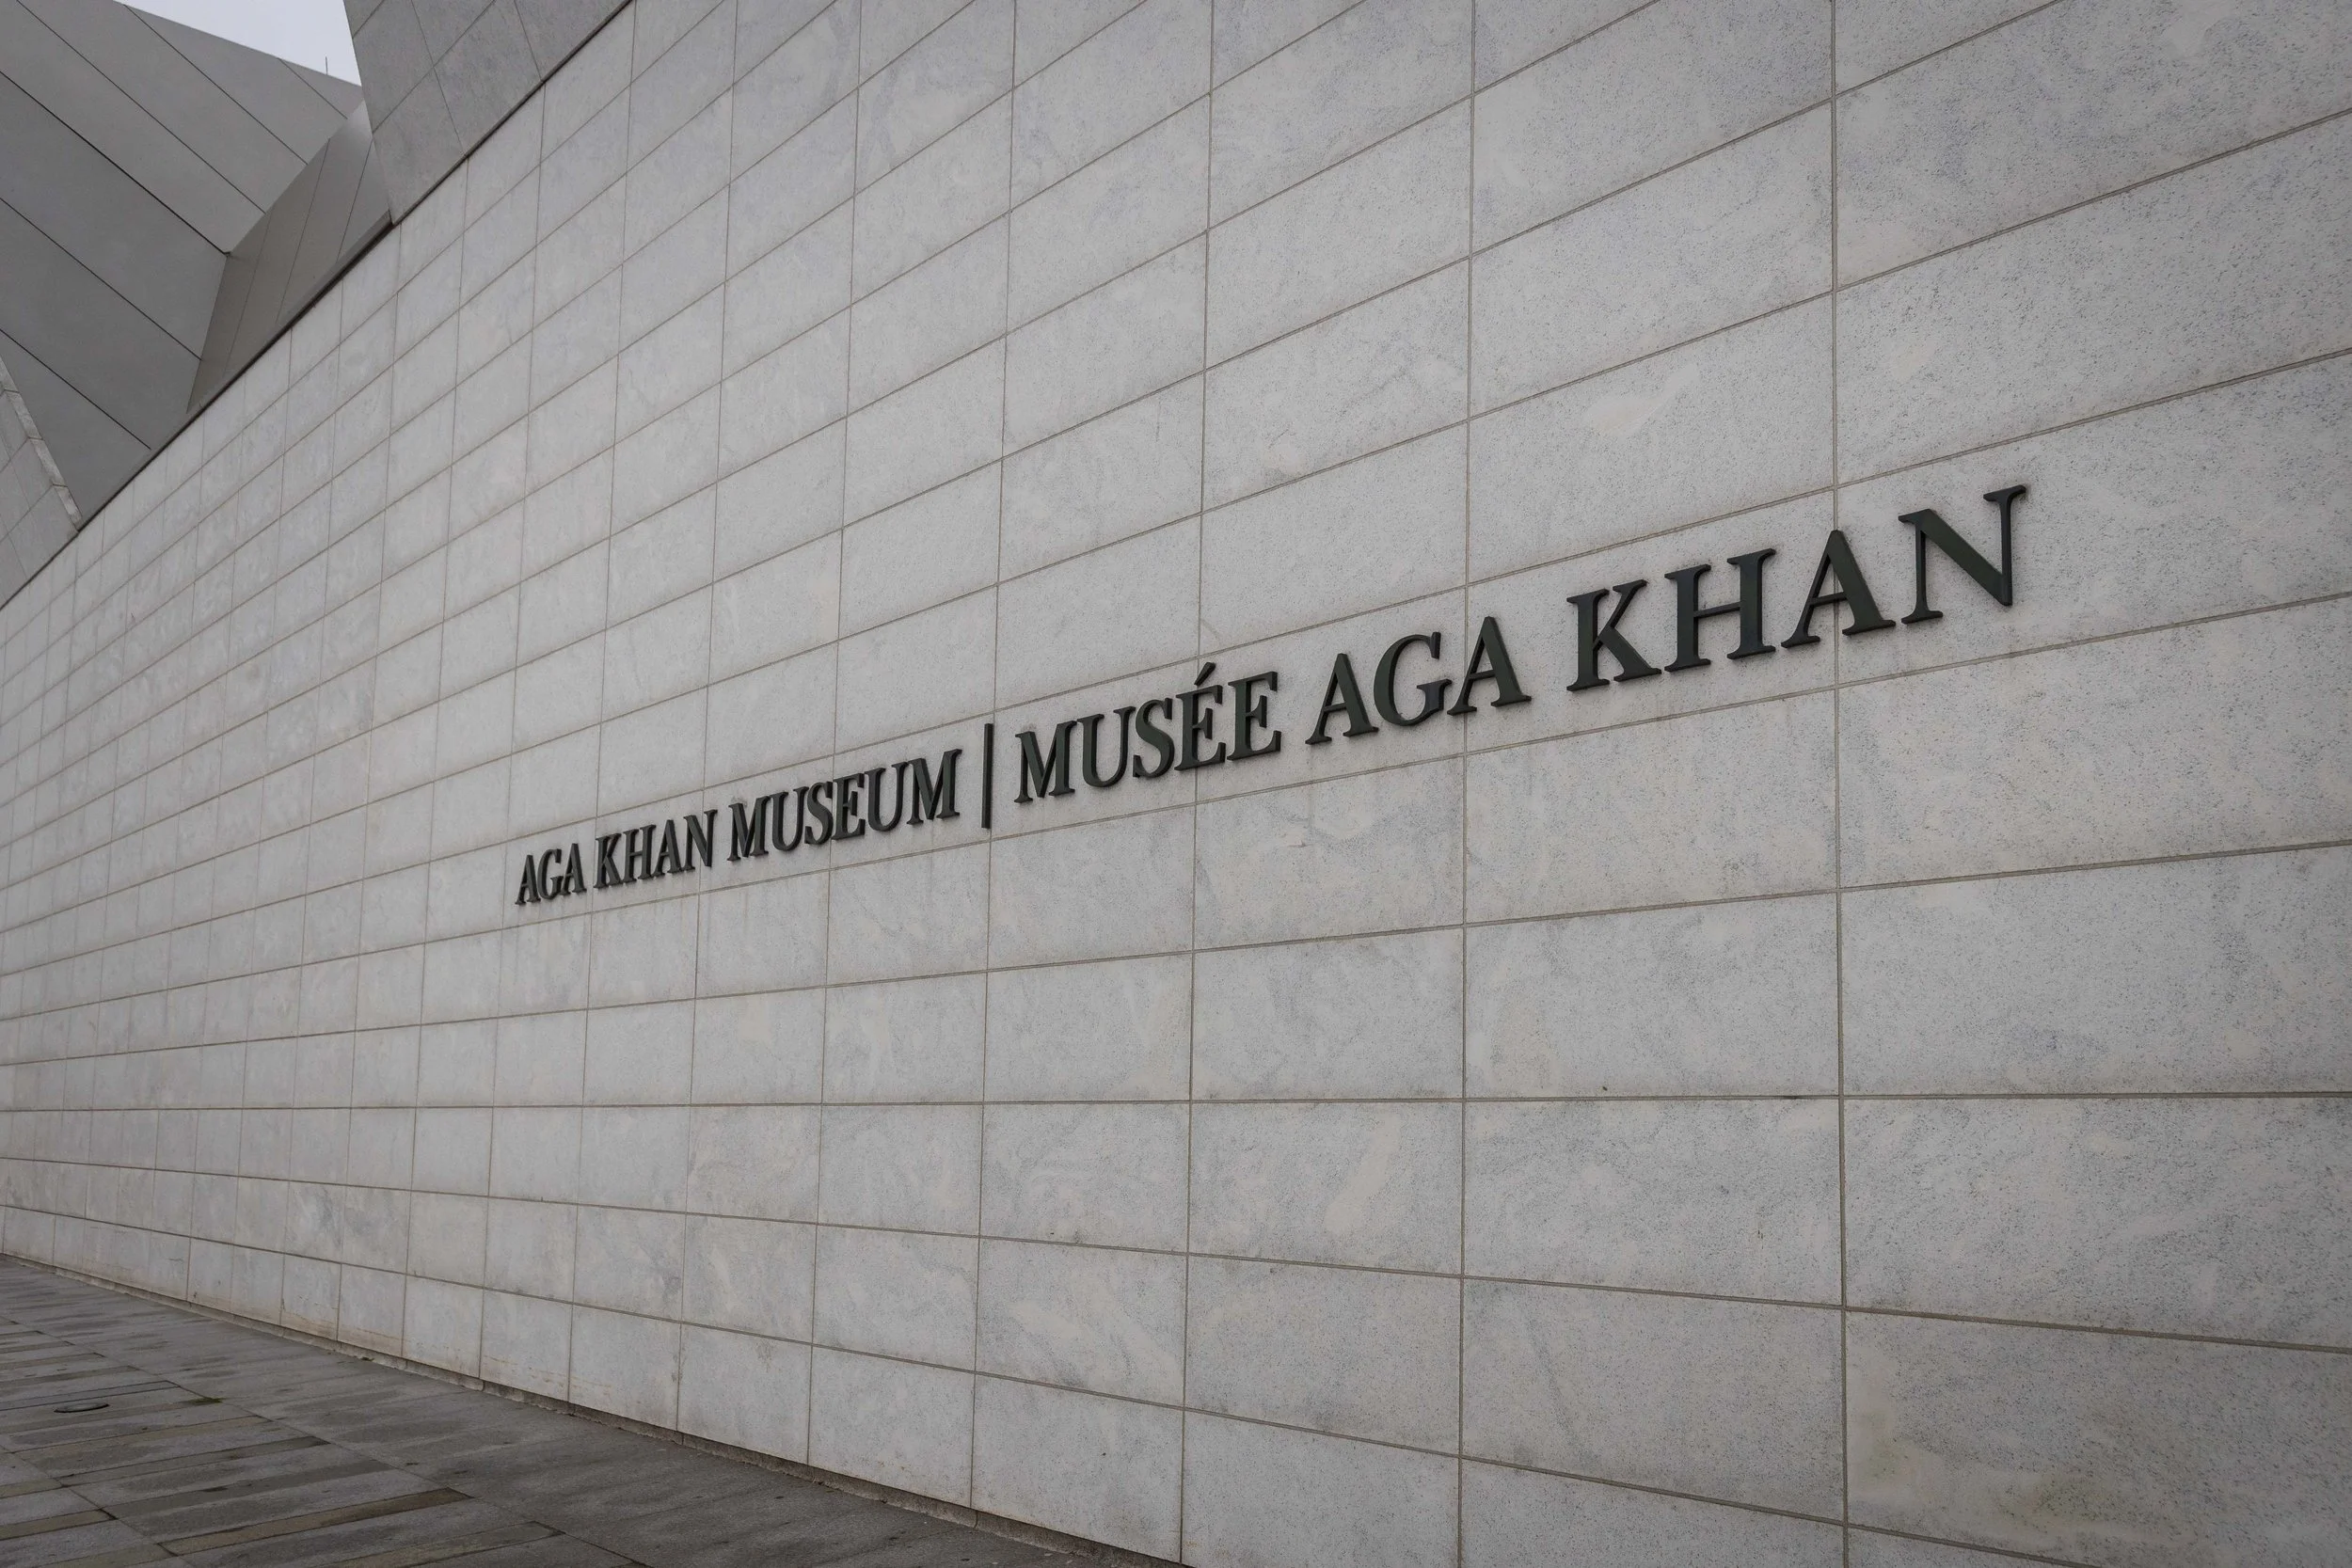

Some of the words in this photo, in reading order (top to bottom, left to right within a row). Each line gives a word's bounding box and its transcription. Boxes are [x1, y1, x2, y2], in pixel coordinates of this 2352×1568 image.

[515, 843, 588, 906] AGA
[593, 809, 719, 890] KHAN
[726, 748, 962, 863] MUSEUM
[1013, 662, 1282, 805] MUSÉE
[1304, 615, 1533, 748] AGA
[1565, 484, 2029, 694] KHAN
